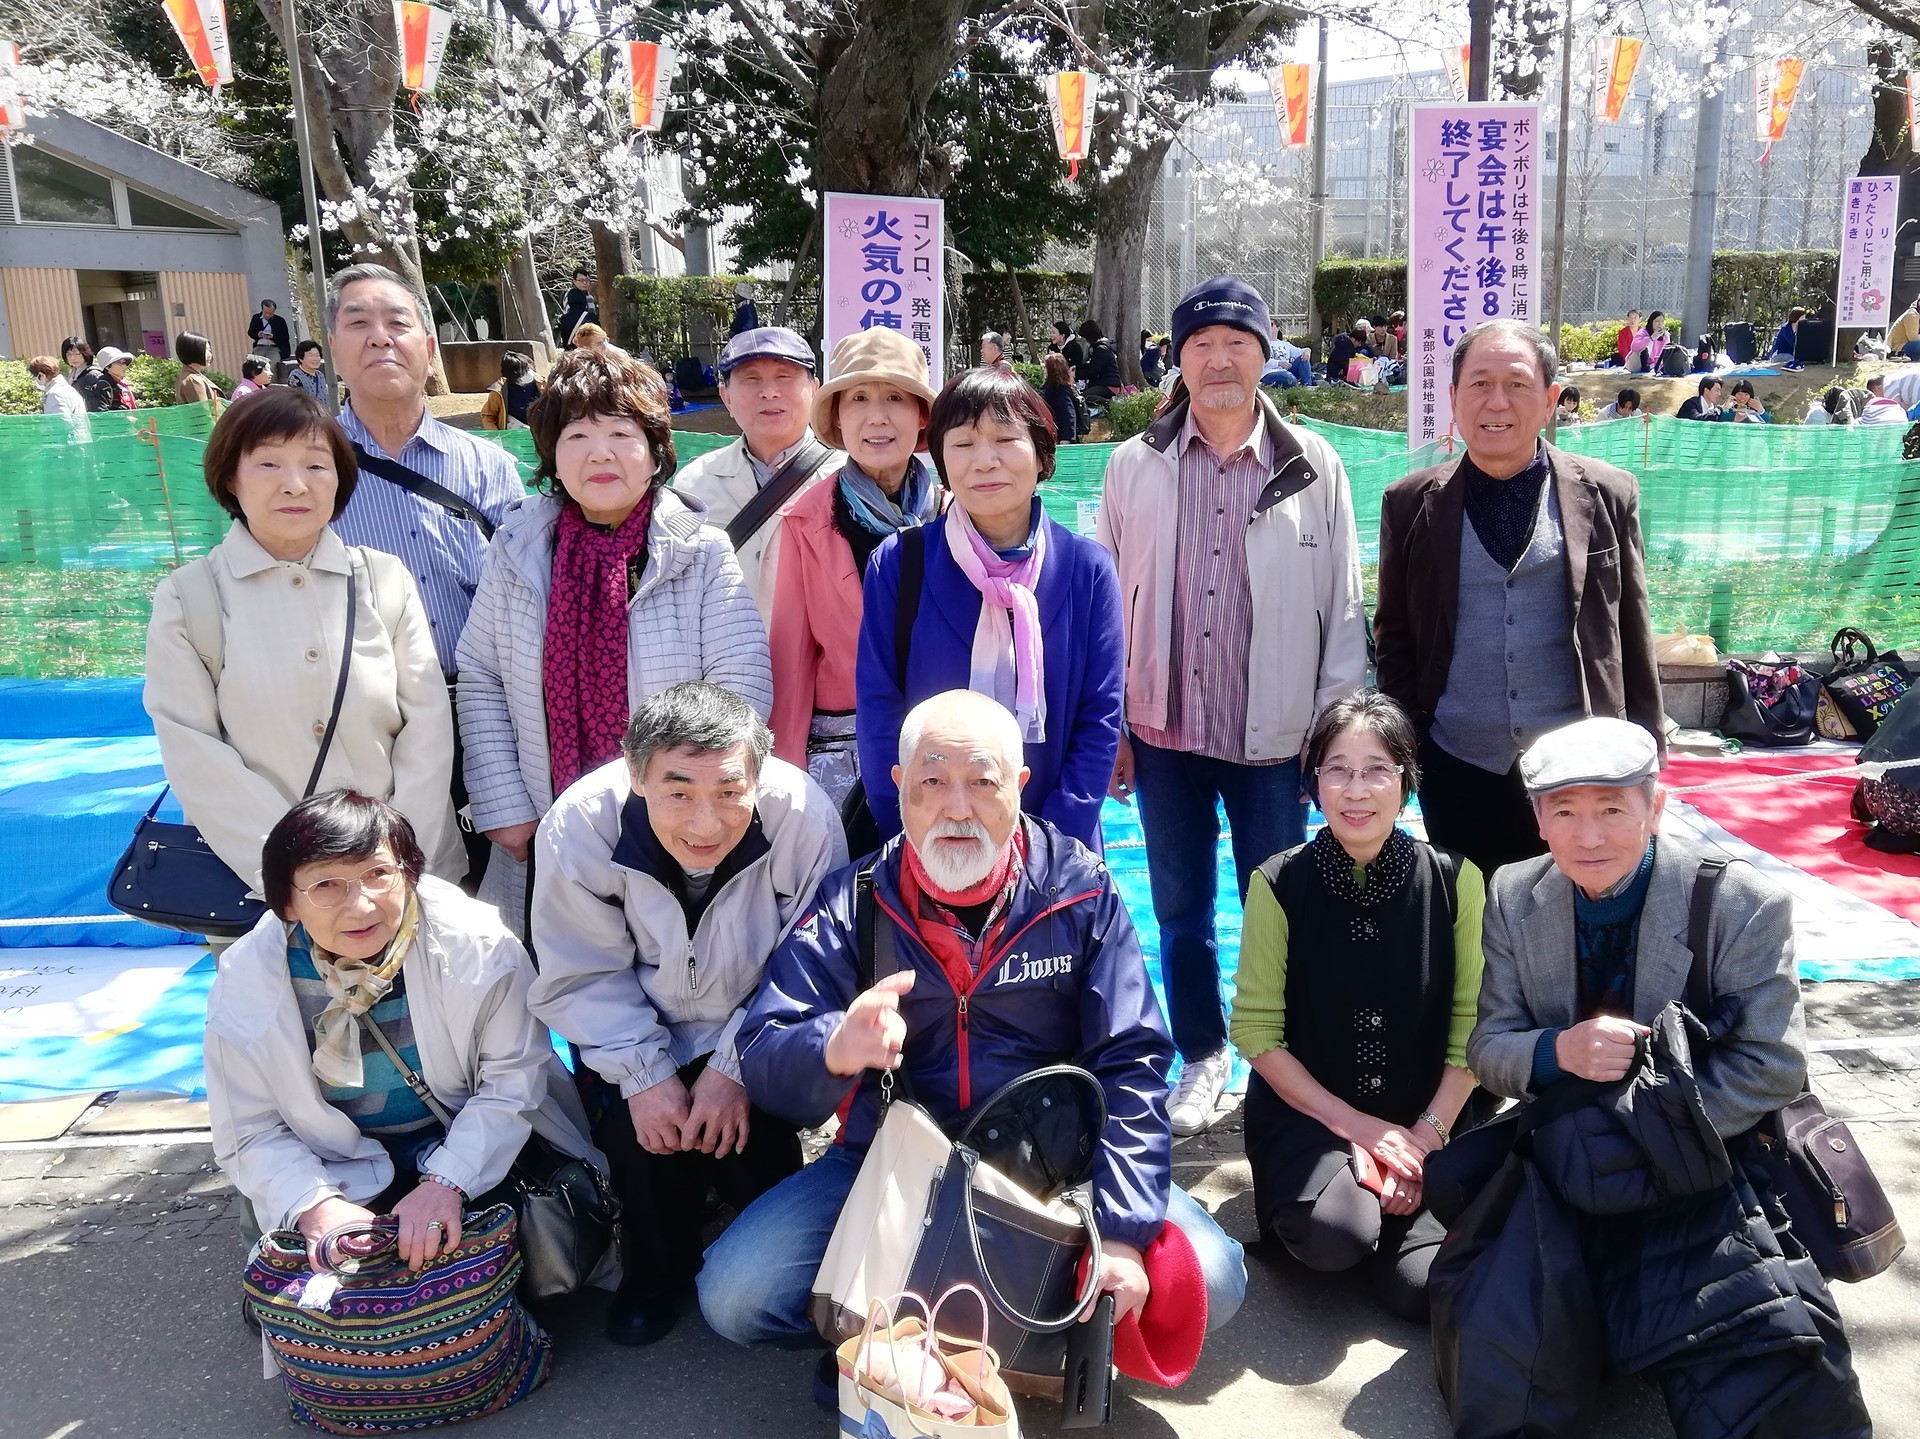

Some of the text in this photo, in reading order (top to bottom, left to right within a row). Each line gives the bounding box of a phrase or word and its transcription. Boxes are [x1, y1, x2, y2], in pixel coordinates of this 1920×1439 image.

[209, 15, 226, 54] ABAB
[428, 32, 443, 69] ABAB
[656, 69, 671, 107] ABAB
[1597, 57, 1608, 96] ABAB
[1758, 77, 1770, 116] ABAB
[1475, 119, 1508, 325] 宴会は午後8
[1511, 118, 1529, 321] ボンボリは午後8時に消
[1849, 182, 1862, 239] 置き引き
[1440, 119, 1472, 347] 終了してください
[1860, 182, 1879, 290] ひったくりにご用心
[1194, 300, 1254, 311] Champion
[1422, 328, 1435, 439] 東部公園緑地事務所
[994, 951, 1073, 987] Lions
